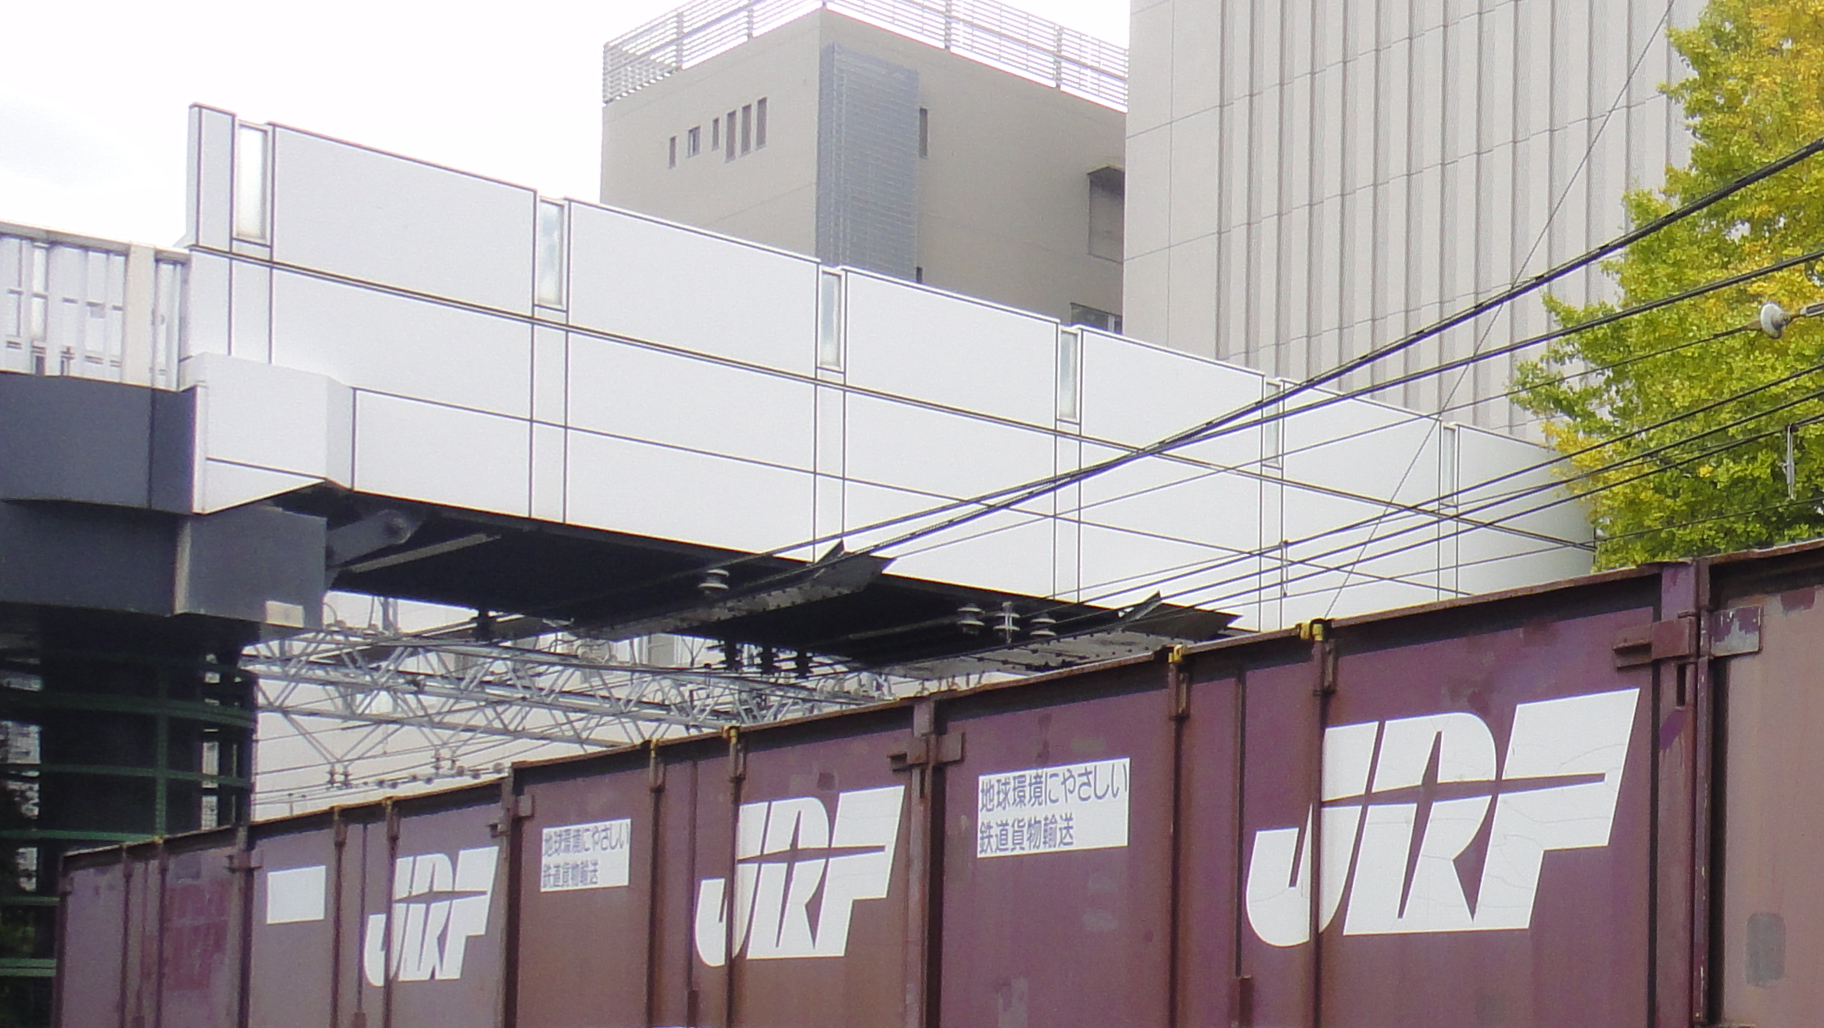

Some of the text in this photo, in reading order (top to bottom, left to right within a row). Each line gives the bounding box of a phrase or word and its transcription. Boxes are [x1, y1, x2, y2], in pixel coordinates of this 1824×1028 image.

[979, 763, 1128, 813] 地球環境にやさしい
[979, 812, 1074, 854] 鉄道貨物輸送
[1246, 688, 1640, 948] JRF
[364, 846, 499, 987] JRF
[695, 785, 906, 967] JRF
